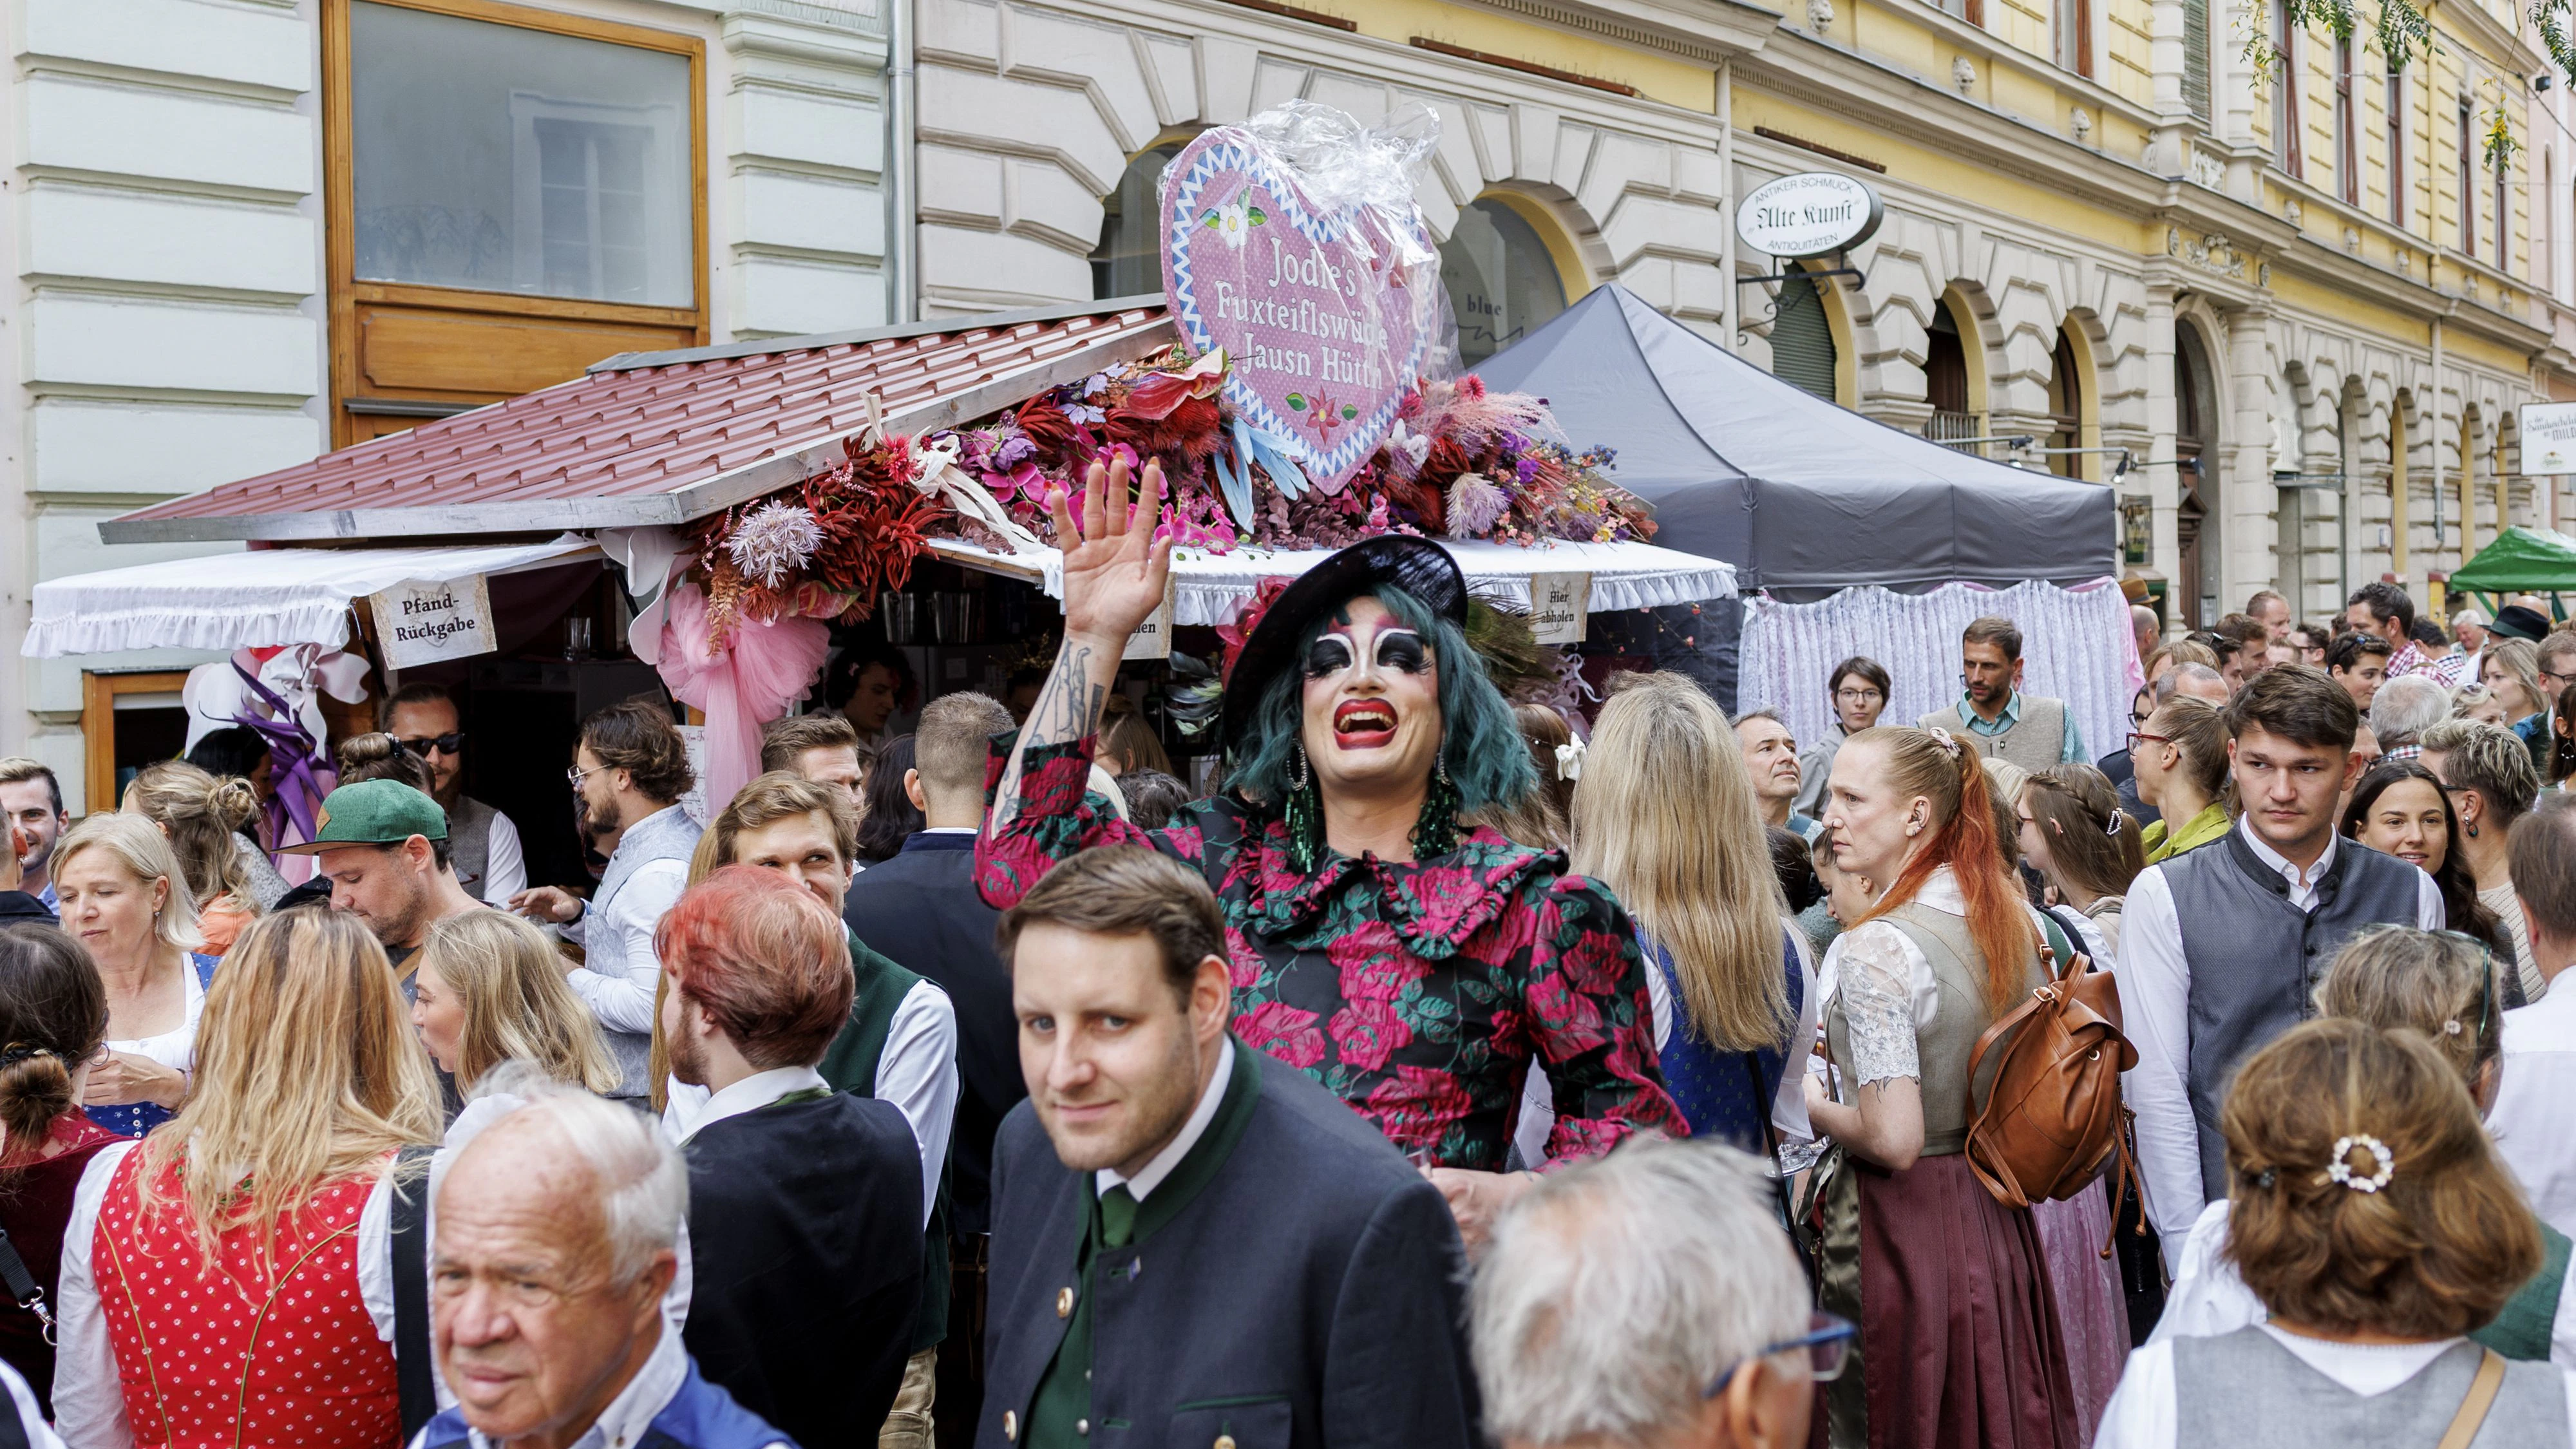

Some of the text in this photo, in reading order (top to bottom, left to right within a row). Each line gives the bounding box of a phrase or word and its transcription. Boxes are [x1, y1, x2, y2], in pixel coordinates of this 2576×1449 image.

[1754, 177, 1854, 205] ANTIKER SCHMUCK
[1768, 233, 1839, 251] ANTIQUITÄTEN
[1268, 236, 1356, 297] Jodle's
[1467, 294, 1501, 316] blue
[1242, 332, 1383, 390] Jausn Hüttn
[402, 593, 459, 615] Pfand-
[1550, 591, 1569, 603] Hier
[1541, 610, 1574, 623] abholen
[395, 617, 475, 641] Rückgabe
